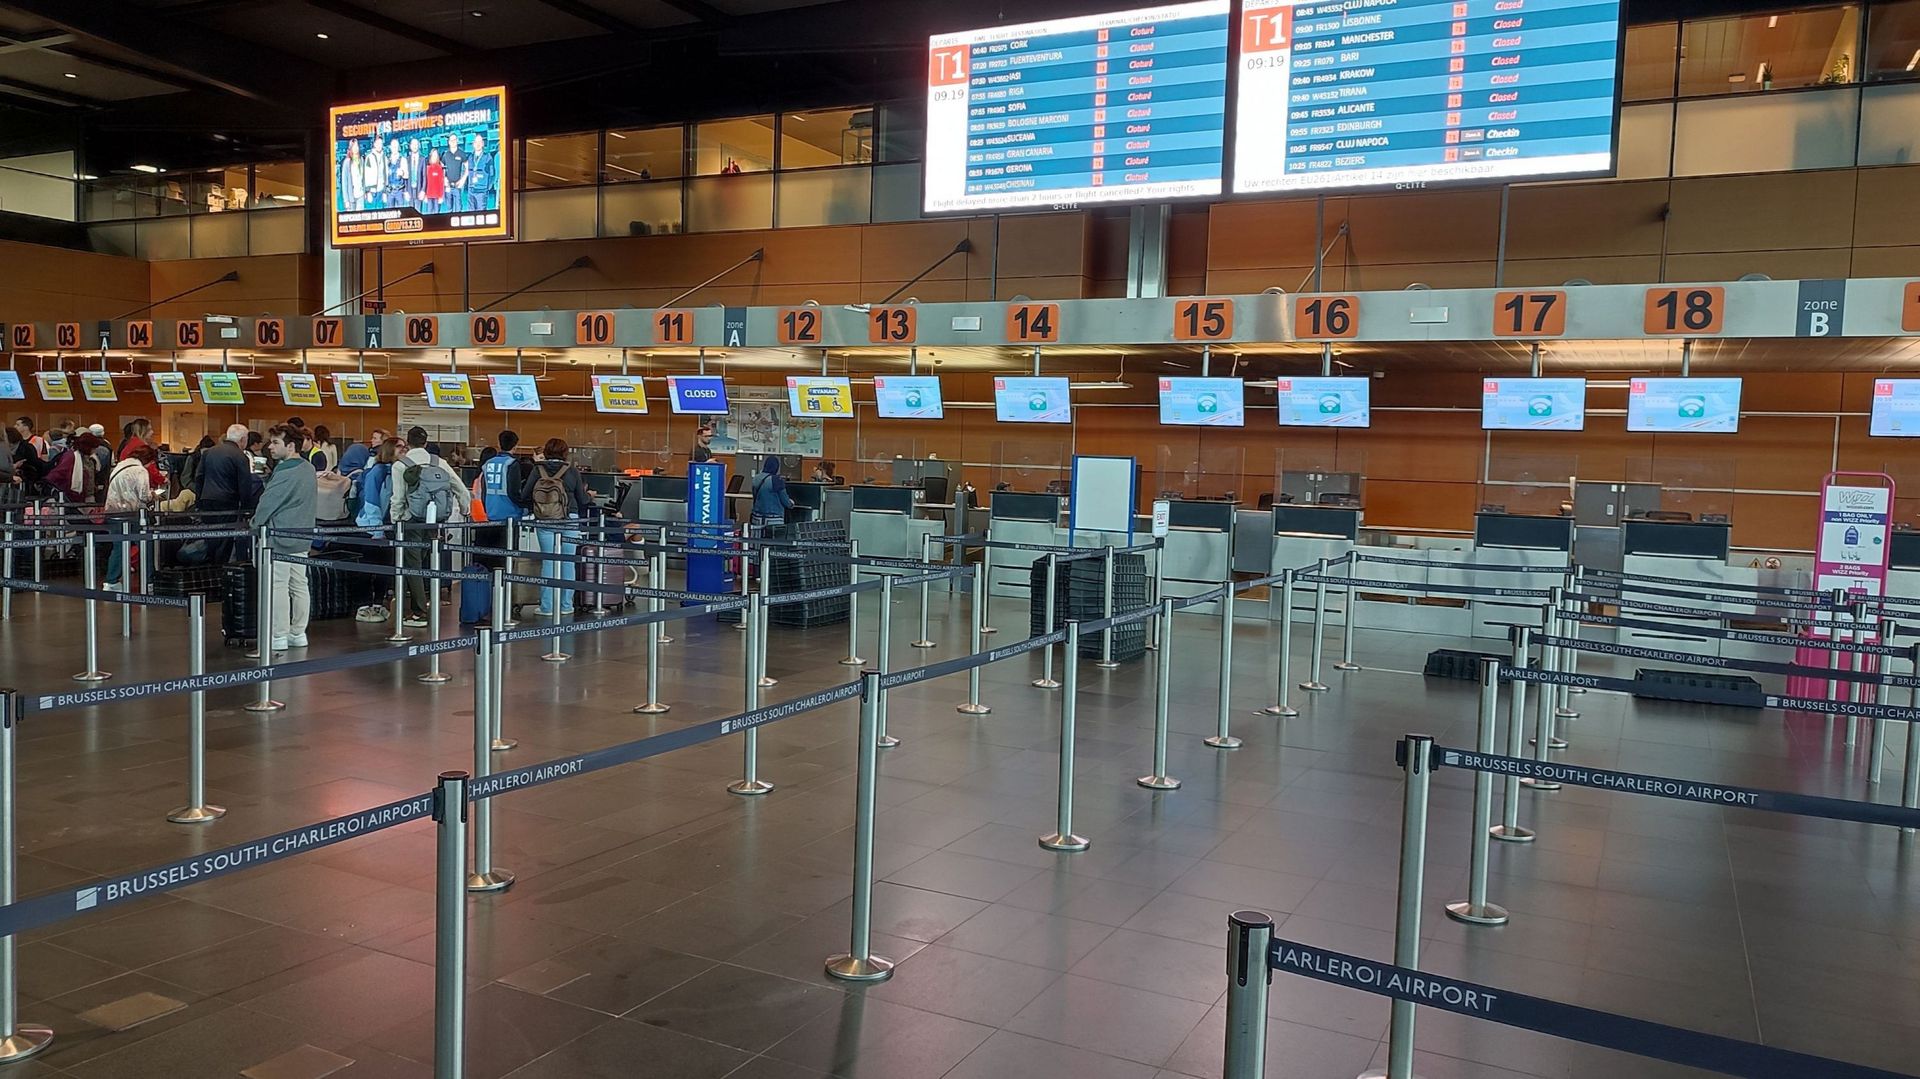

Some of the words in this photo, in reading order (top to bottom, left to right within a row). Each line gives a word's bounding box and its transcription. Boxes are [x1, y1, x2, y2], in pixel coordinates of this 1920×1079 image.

[1249, 12, 1286, 47] T1
[1341, 31, 1395, 44] MANCHESTER
[1493, 18, 1522, 29] Closed
[1342, 14, 1382, 27] LISBONNE
[1009, 39, 1028, 49] CORK
[1340, 52, 1359, 63] BARI
[1492, 36, 1521, 48] Closed
[935, 50, 966, 81] T1
[1009, 51, 1063, 65] FUERTEVENTURA
[1247, 56, 1285, 70] 09:19
[1339, 68, 1375, 80] KRAKOW
[1491, 55, 1520, 66] Closed
[1008, 87, 1025, 97] RIGA
[1339, 86, 1367, 98] TIRANA
[1490, 73, 1519, 85] Closed
[1007, 102, 1027, 112] SOFIA
[1337, 102, 1375, 115] ALICANTE
[1489, 92, 1518, 103] Closed
[342, 121, 381, 138] SECURITY
[382, 121, 392, 133] IS
[444, 108, 492, 126] CONCERN!
[1007, 116, 1038, 128] BOLOGNE
[1038, 113, 1070, 125] MARCONI
[1336, 120, 1382, 132] EDINBURGH
[1488, 110, 1517, 121] Closed
[1006, 132, 1036, 143] SUCEAVA
[1335, 139, 1355, 149] CLUJ
[1355, 136, 1389, 147] NAPOCA
[1486, 127, 1520, 139] Checkin
[1006, 149, 1025, 159] GRAN
[1025, 146, 1054, 158] CANARIA
[1335, 156, 1365, 166] BEZIERS
[1486, 146, 1518, 157] Checkin
[1005, 163, 1033, 174] GERONA
[1504, 294, 1557, 332] 17
[1656, 290, 1713, 330] 18
[1803, 298, 1838, 312] zone
[581, 314, 609, 342] 10
[659, 313, 684, 341] 11
[726, 321, 744, 330] zone
[783, 311, 815, 341] 12
[875, 309, 909, 341] 13
[1014, 306, 1052, 339] 14
[1183, 302, 1225, 337] 15
[1304, 299, 1350, 335] 16
[1810, 313, 1829, 337] B
[14, 325, 31, 347] 02
[58, 324, 75, 346] 03
[130, 323, 148, 345] 04
[179, 322, 200, 345] 05
[258, 321, 280, 344] 06
[315, 320, 339, 344] 07
[369, 333, 379, 348] A
[408, 318, 433, 342] 08
[474, 316, 500, 343] 09
[729, 330, 740, 347] A
[609, 398, 623, 407] VISA
[623, 399, 639, 407] CHECK
[684, 389, 717, 399] CLOSED
[812, 387, 839, 396] RYANAIR
[1599, 596, 1629, 607] BRUSSELS
[1629, 600, 1653, 609] SOUTH
[1653, 603, 1692, 614] CHARLEROI
[1692, 608, 1722, 618] AIRPORT
[1713, 594, 1742, 603] BRUSSELS
[1742, 597, 1765, 606] SOUTH
[1765, 600, 1803, 609] CHARLEROI
[1803, 603, 1832, 611] AIRPORT
[508, 629, 541, 640] BRUSSELS
[541, 625, 565, 637] SOUTH
[565, 621, 602, 633] CHARLEROI
[602, 617, 628, 628] AIRPORT
[1581, 614, 1613, 624] AIRPORT
[1790, 617, 1822, 627] BRUSSELS
[1823, 620, 1849, 629] SOUTH
[419, 639, 456, 654] BRUSSELS
[457, 636, 478, 648] SOUT
[1559, 638, 1600, 651] BRUSSELS
[1600, 643, 1632, 655] SOUTH
[1633, 647, 1686, 661] CHARLEROI
[1686, 655, 1728, 668] AIRPORT
[1737, 632, 1775, 644] BRUSSELS
[1776, 636, 1805, 646] SOUTH
[1807, 639, 1856, 652] CHARLEROI
[1857, 645, 1895, 655] AIRPORT
[57, 687, 118, 707] BRUSSELS
[118, 682, 162, 699] SOUTH
[163, 673, 229, 693] CHARLEROI
[229, 667, 275, 684] AIRPORT
[880, 673, 903, 688] ARLEROI
[903, 669, 925, 682] AIRPORT
[1552, 673, 1599, 687] AIRPORT
[732, 708, 767, 731] BRUSSELS
[768, 701, 795, 720] SOUTH
[795, 691, 834, 712] CHARLEROI
[834, 683, 861, 701] AIRPORT
[1782, 698, 1838, 712] BRUSSELS
[1840, 703, 1884, 717] SOUTH
[535, 759, 584, 780] AIRPORT
[1464, 755, 1531, 776] BRUSSELS
[1534, 765, 1588, 783] SOUTH
[1592, 773, 1682, 796] CHARLEROI
[1685, 785, 1758, 805] AIRPORT
[106, 861, 200, 901] BRUSSELS
[203, 842, 268, 874] SOUTH
[271, 815, 365, 855] CHARLEROI
[366, 797, 431, 827] AIRPORT
[1387, 973, 1497, 1013] AIRPORT
